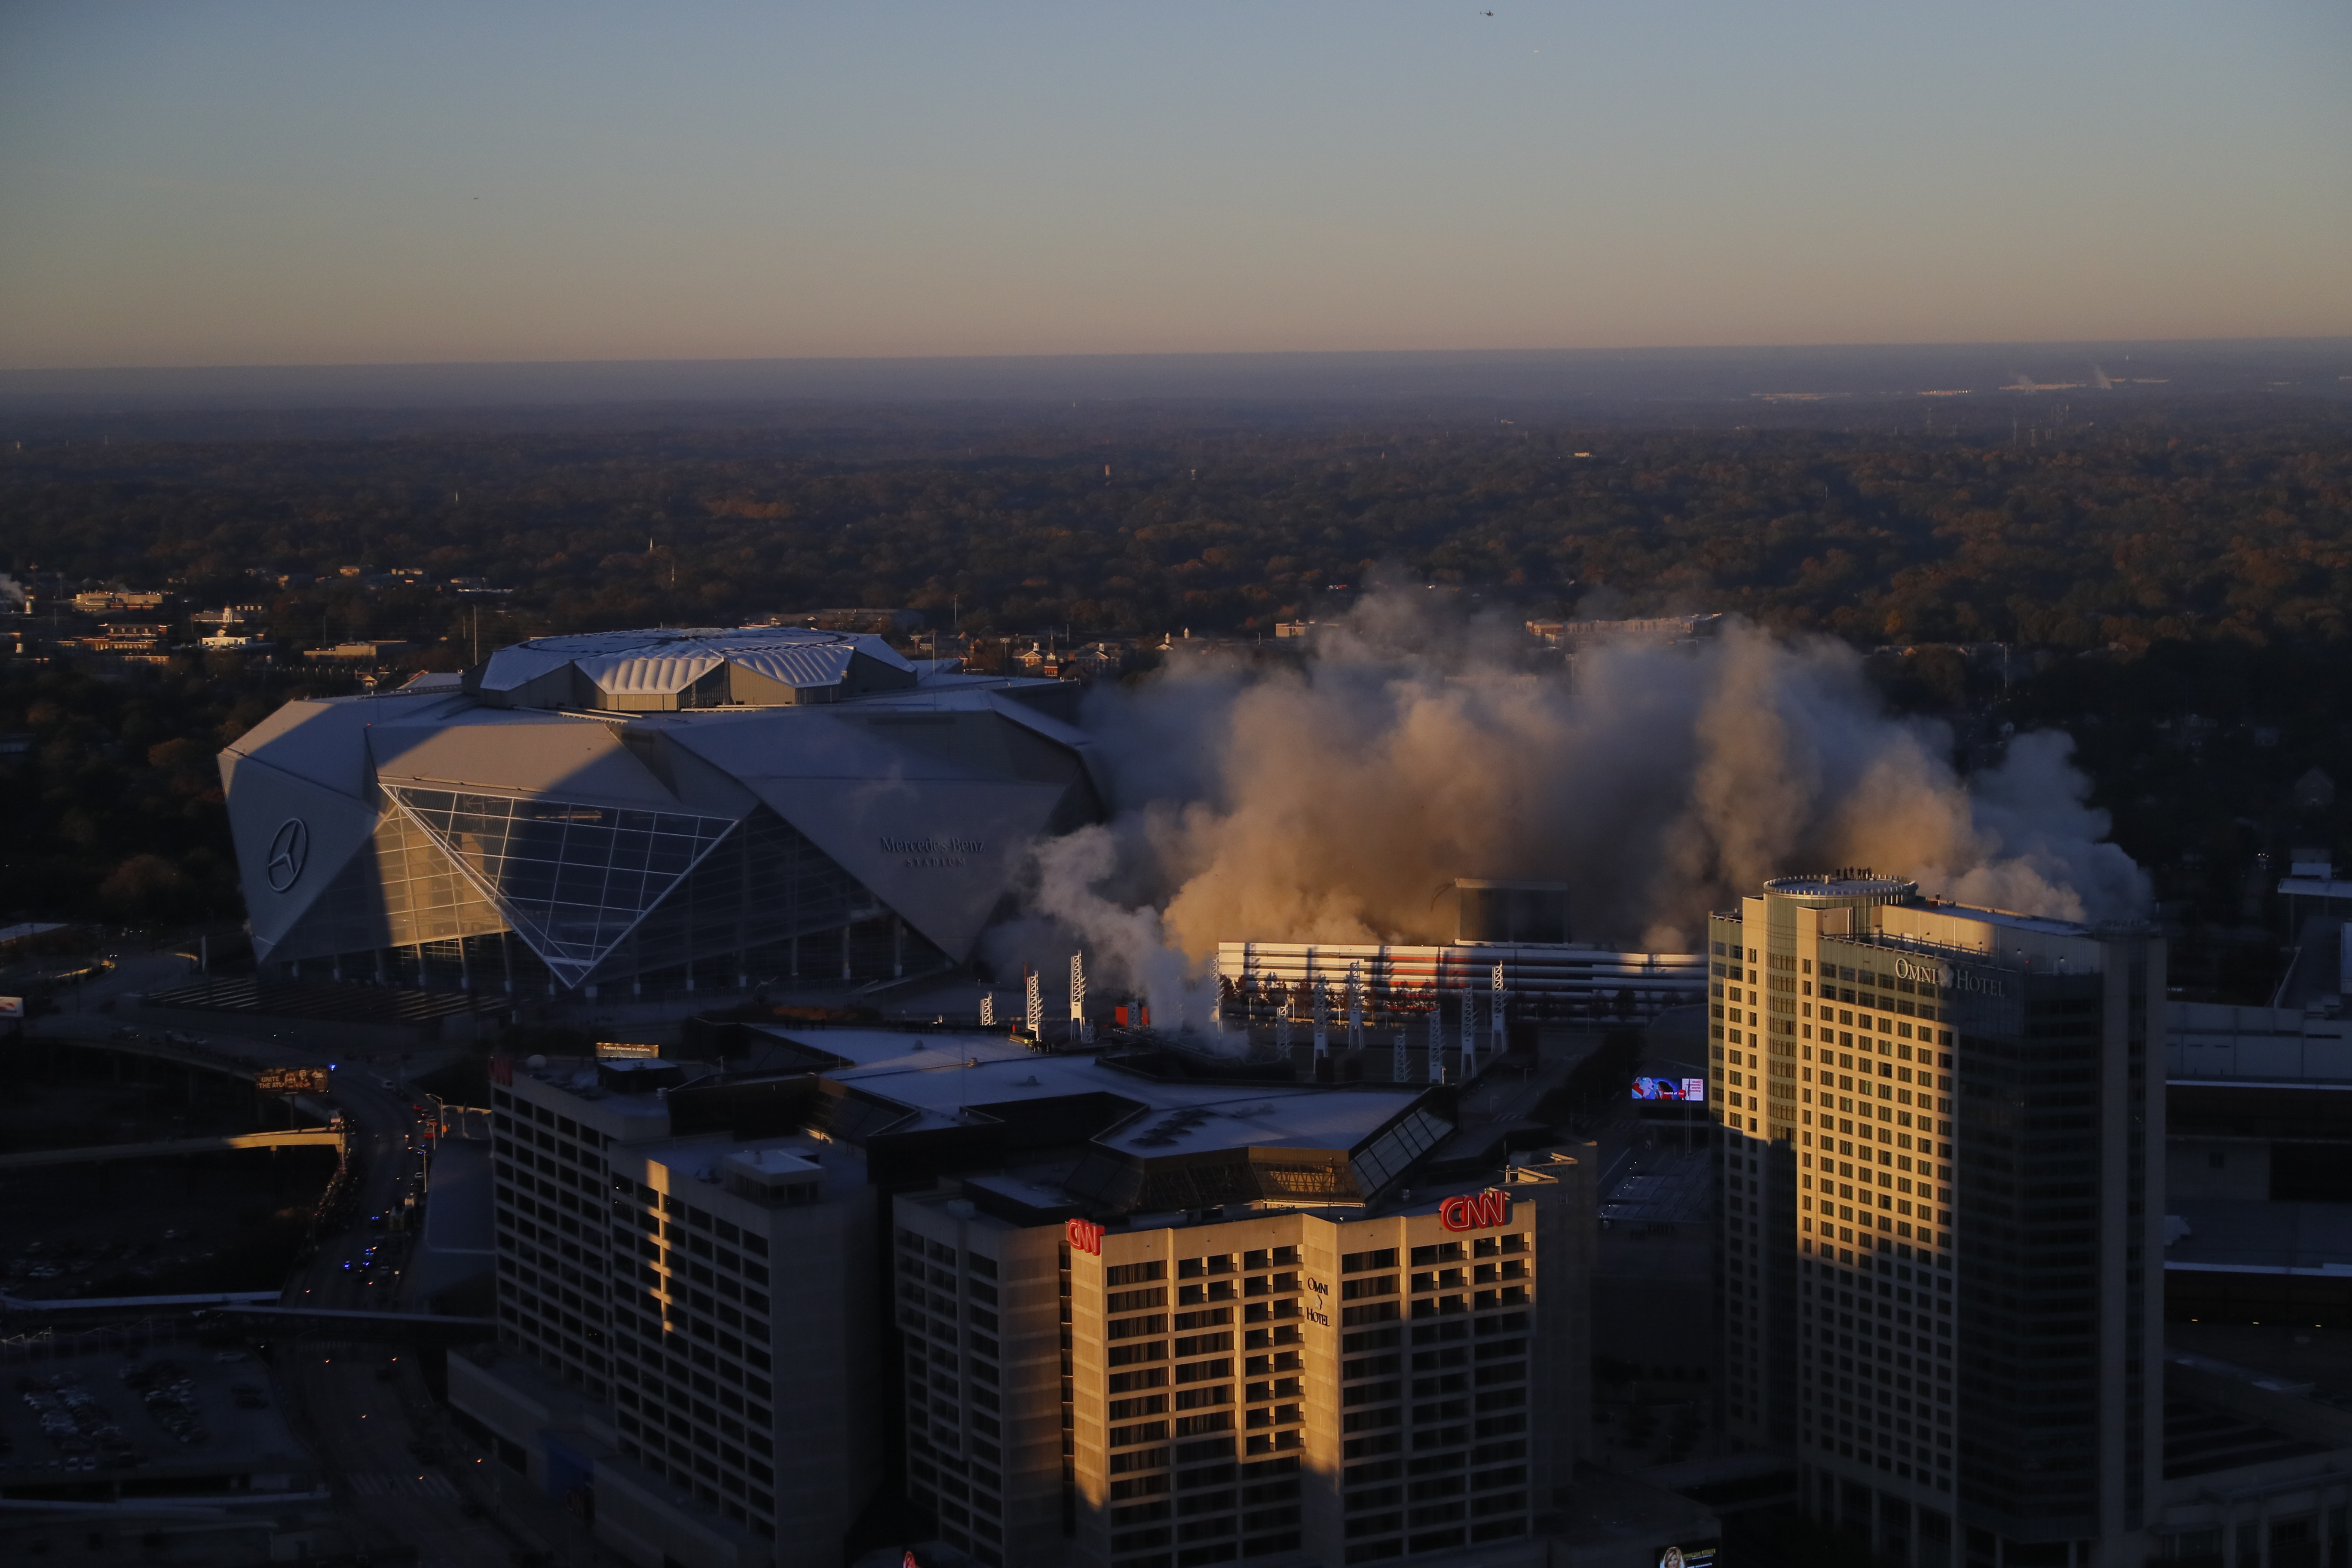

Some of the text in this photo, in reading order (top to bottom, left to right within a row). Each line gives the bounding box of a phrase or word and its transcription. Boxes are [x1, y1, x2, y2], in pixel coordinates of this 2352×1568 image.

[882, 838, 985, 852] Mercedes-Benz
[906, 858, 966, 867] STADIUM
[1896, 958, 2005, 997] OMNI HOTEL
[1439, 1191, 1506, 1232] CNN
[1067, 1218, 1106, 1256] CNN
[1308, 1277, 1328, 1295] OMNI
[1306, 1307, 1330, 1327] HOTEL
